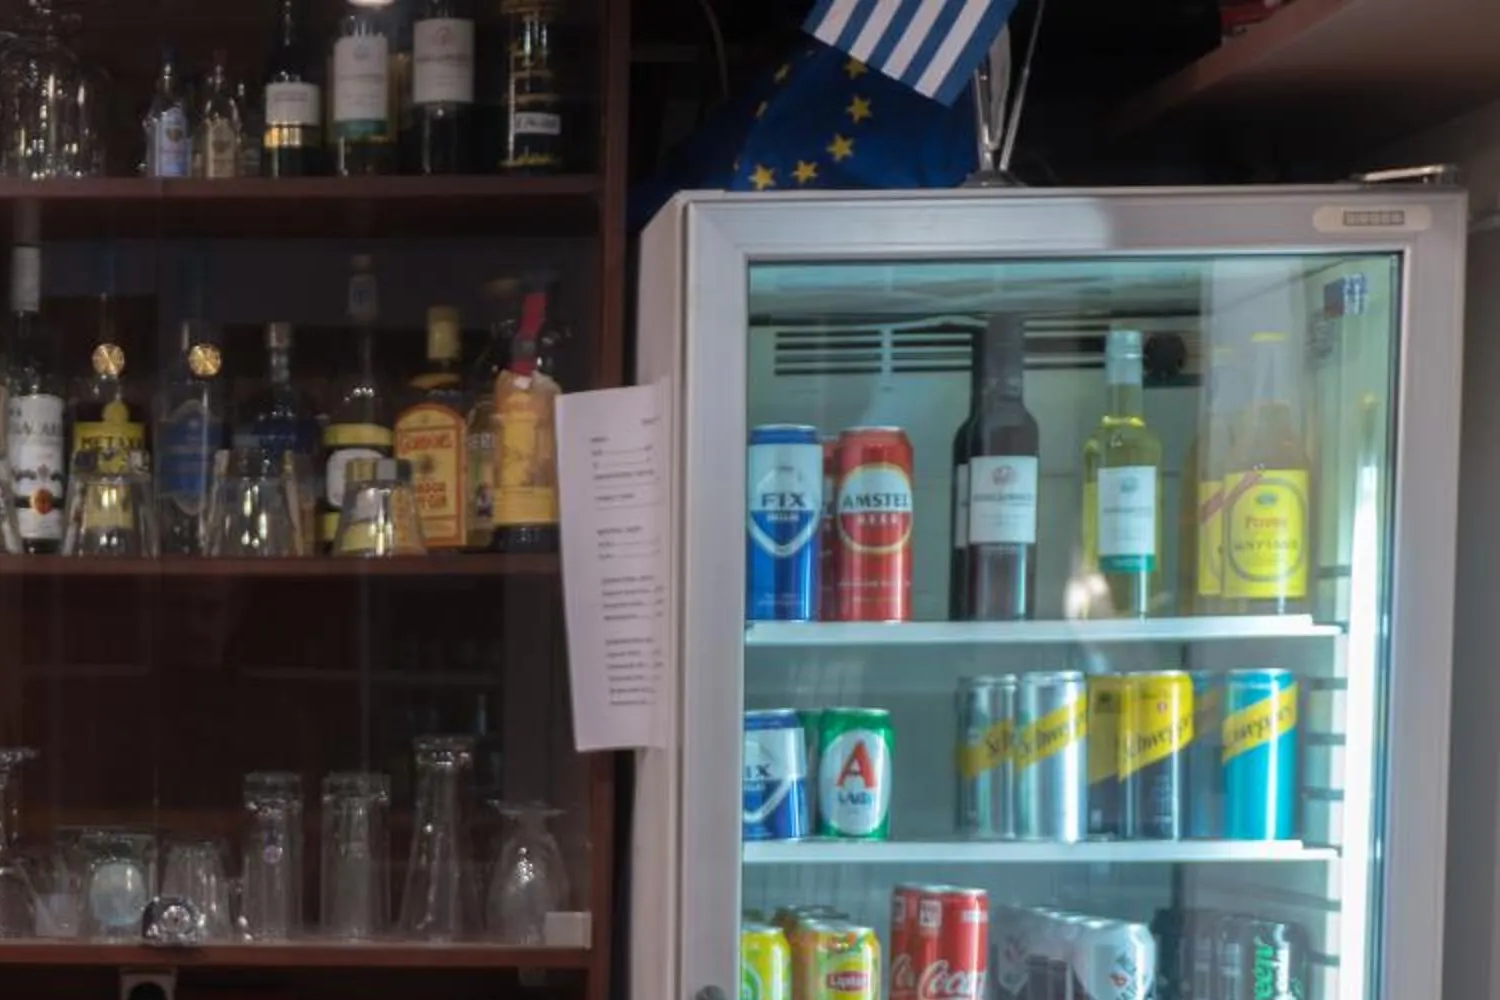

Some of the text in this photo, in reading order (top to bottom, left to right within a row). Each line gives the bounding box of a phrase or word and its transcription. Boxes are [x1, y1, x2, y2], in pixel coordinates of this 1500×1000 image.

[761, 492, 806, 508] FIX
[843, 492, 909, 510] AMSTEL
[829, 974, 869, 990] Lipton
